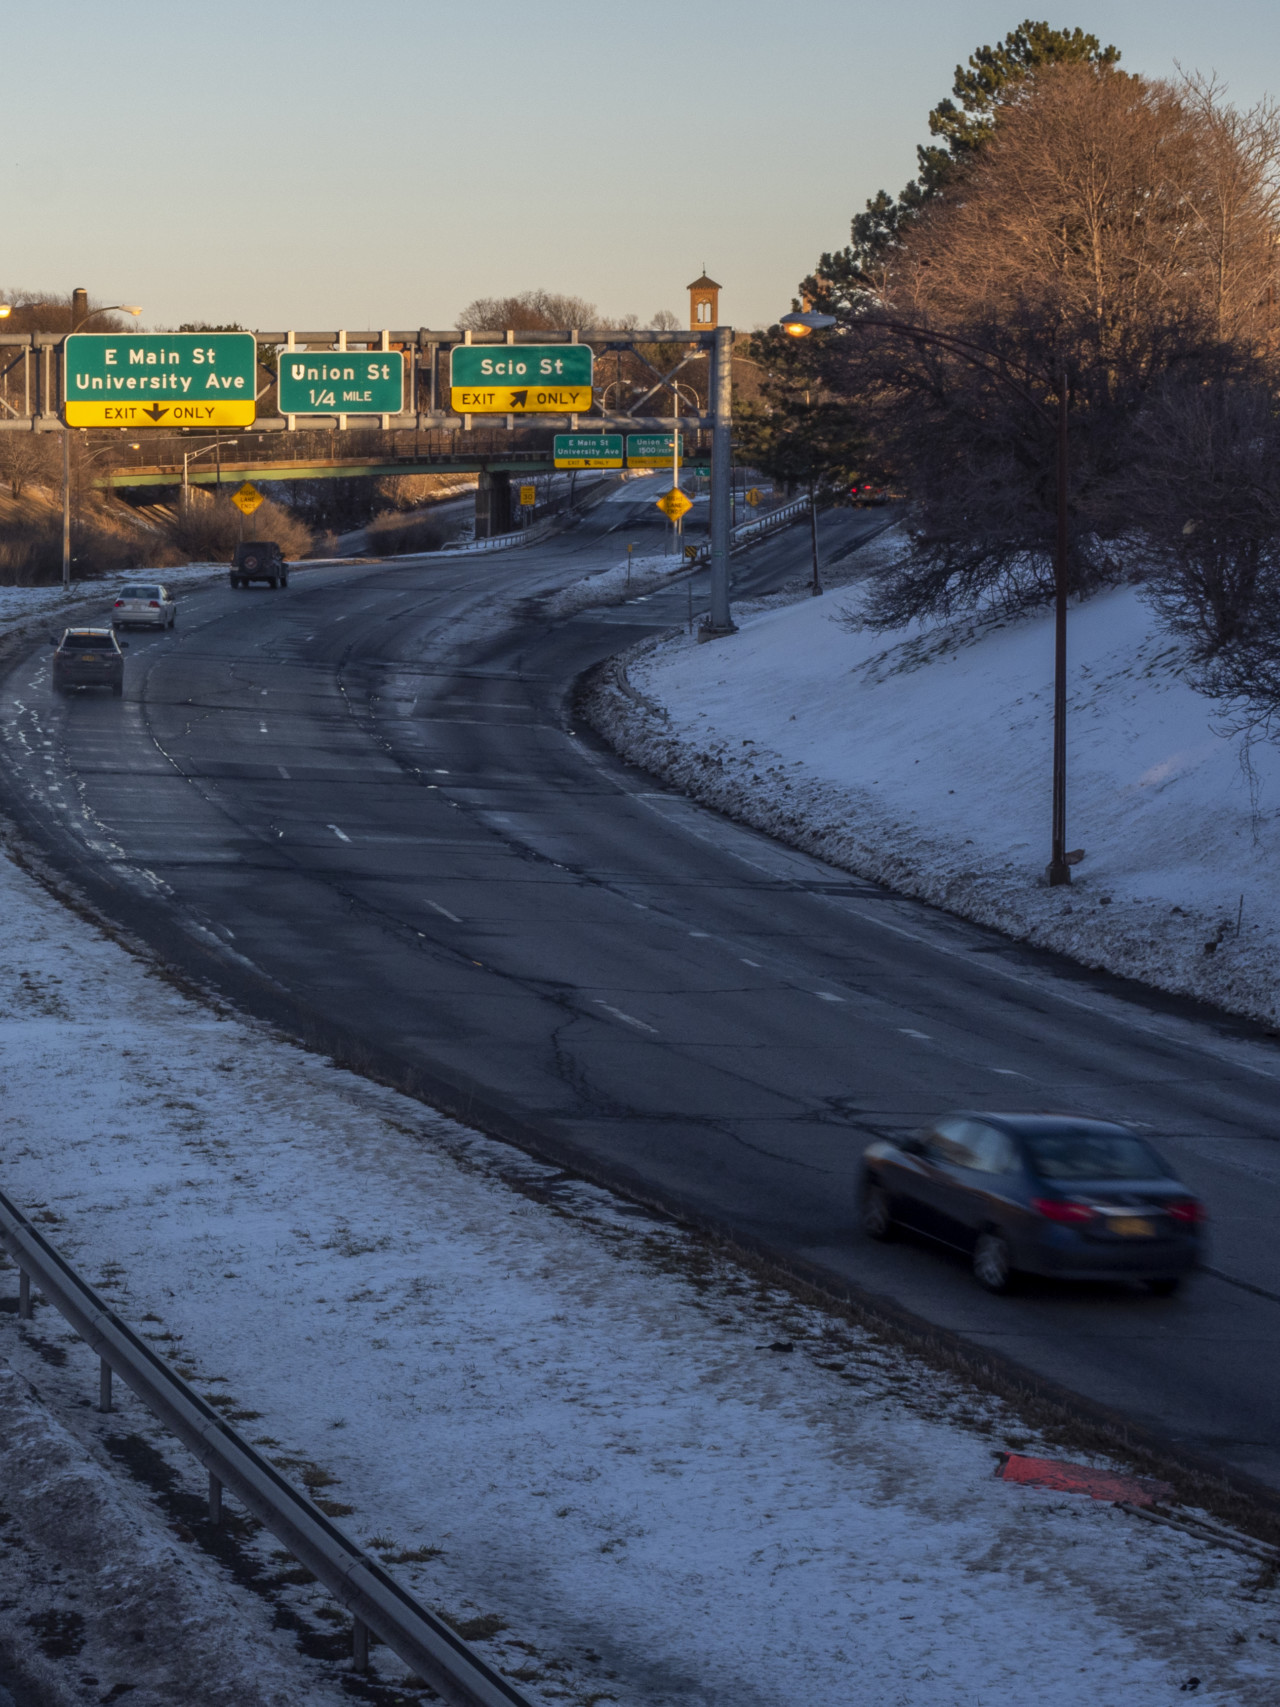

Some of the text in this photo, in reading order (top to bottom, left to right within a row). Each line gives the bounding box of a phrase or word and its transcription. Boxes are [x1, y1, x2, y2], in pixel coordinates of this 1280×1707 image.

[104, 347, 216, 365] E Main St
[291, 363, 390, 381] Union St
[480, 358, 564, 376] Scio St
[76, 372, 245, 393] University Ave
[310, 388, 373, 407] 1/4 MILE
[462, 392, 580, 405] EXIT ONLY
[104, 406, 216, 420] EXIT ONLY
[557, 448, 600, 456] University
